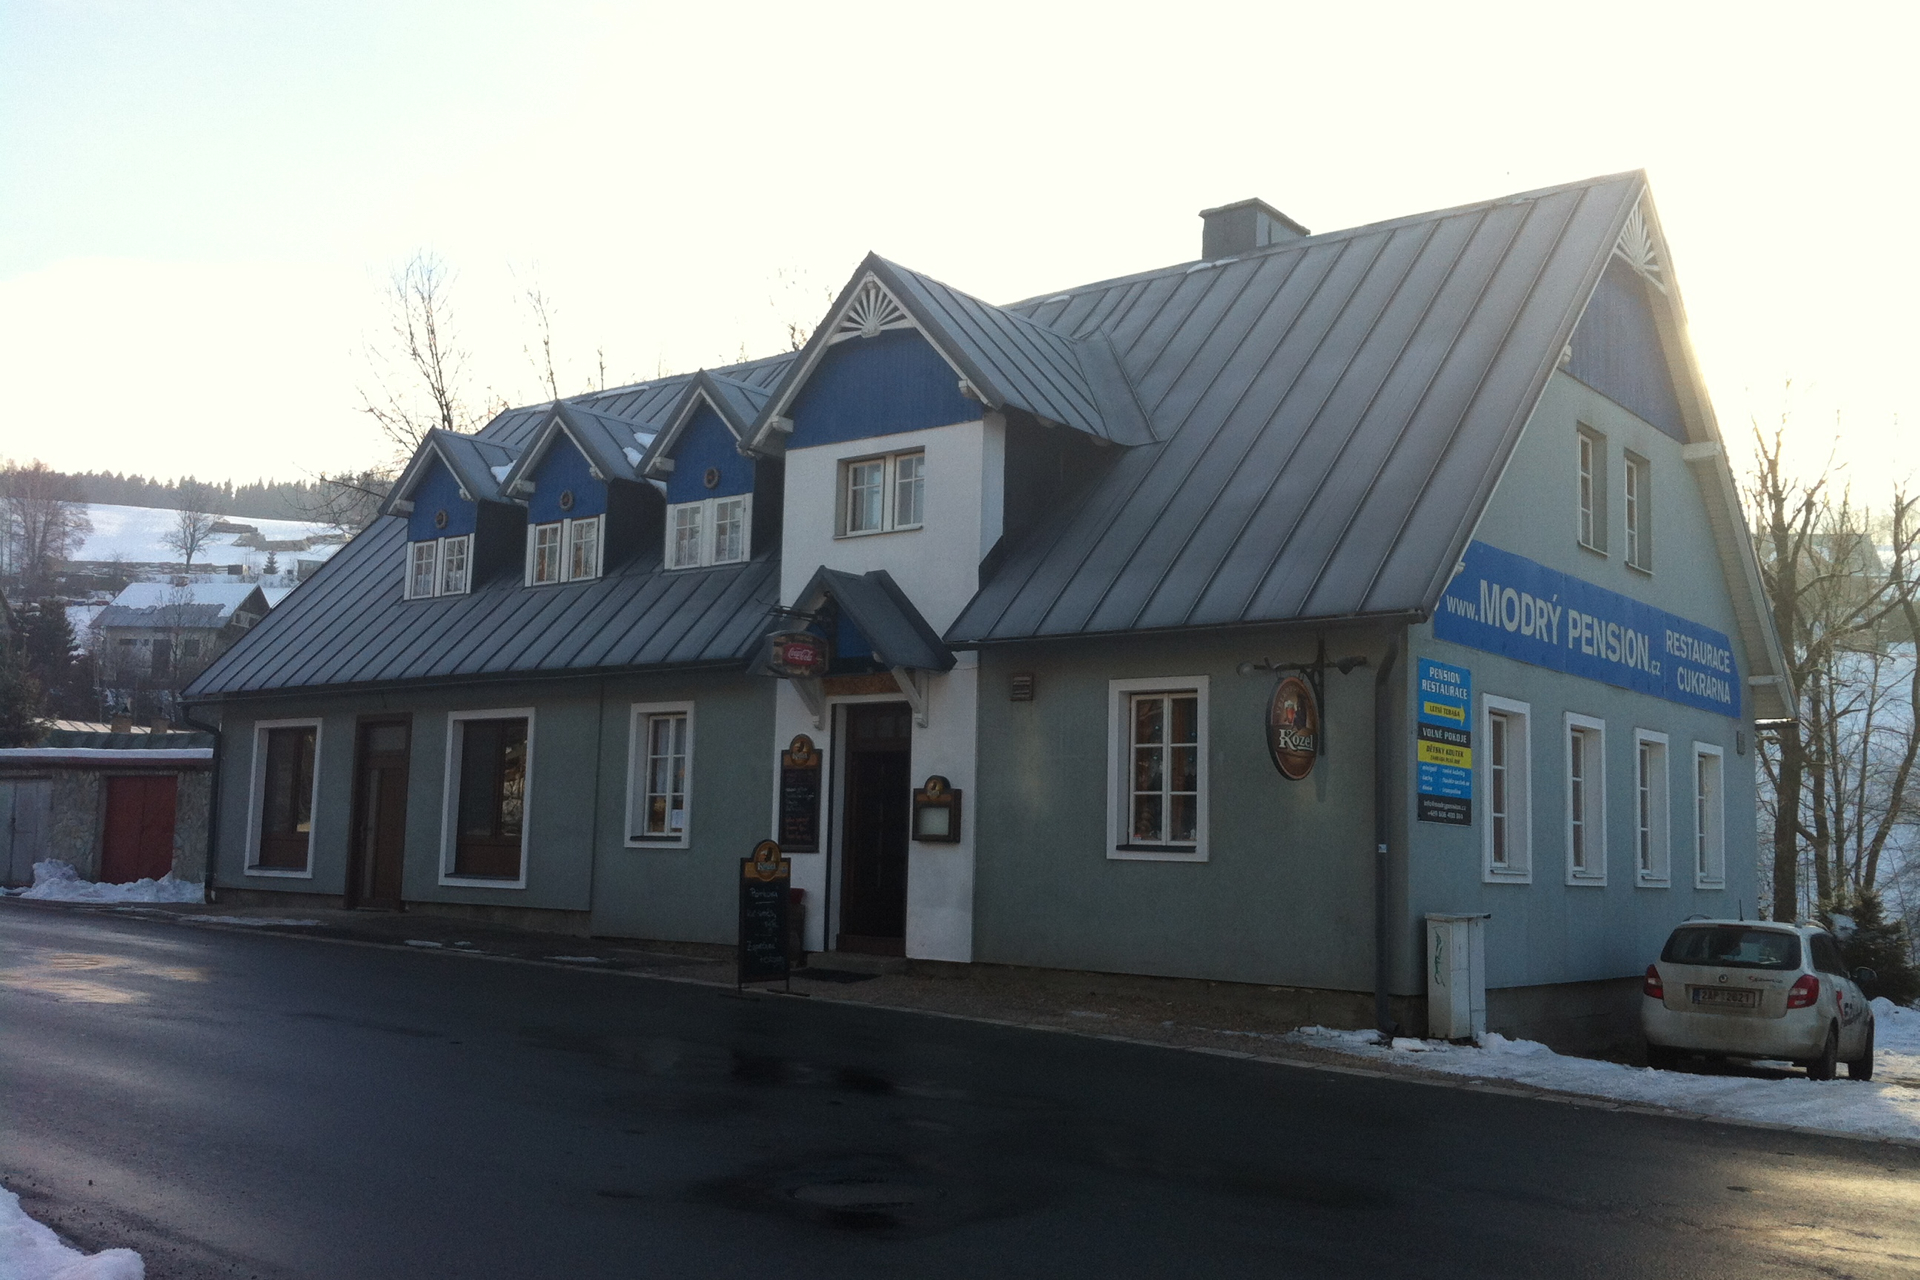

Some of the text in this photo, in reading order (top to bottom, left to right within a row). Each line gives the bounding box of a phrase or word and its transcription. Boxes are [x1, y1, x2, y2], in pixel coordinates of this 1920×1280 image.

[788, 647, 813, 662] Coca-Cola
[1666, 629, 1731, 674] RESTAURACE
[1429, 666, 1460, 684] PENSION
[1677, 666, 1731, 705] CUKRÁRNA
[1421, 679, 1468, 700] RESTAURACE
[1278, 729, 1314, 751] Kozel
[1422, 727, 1467, 744] VOLNÉ POKOJE
